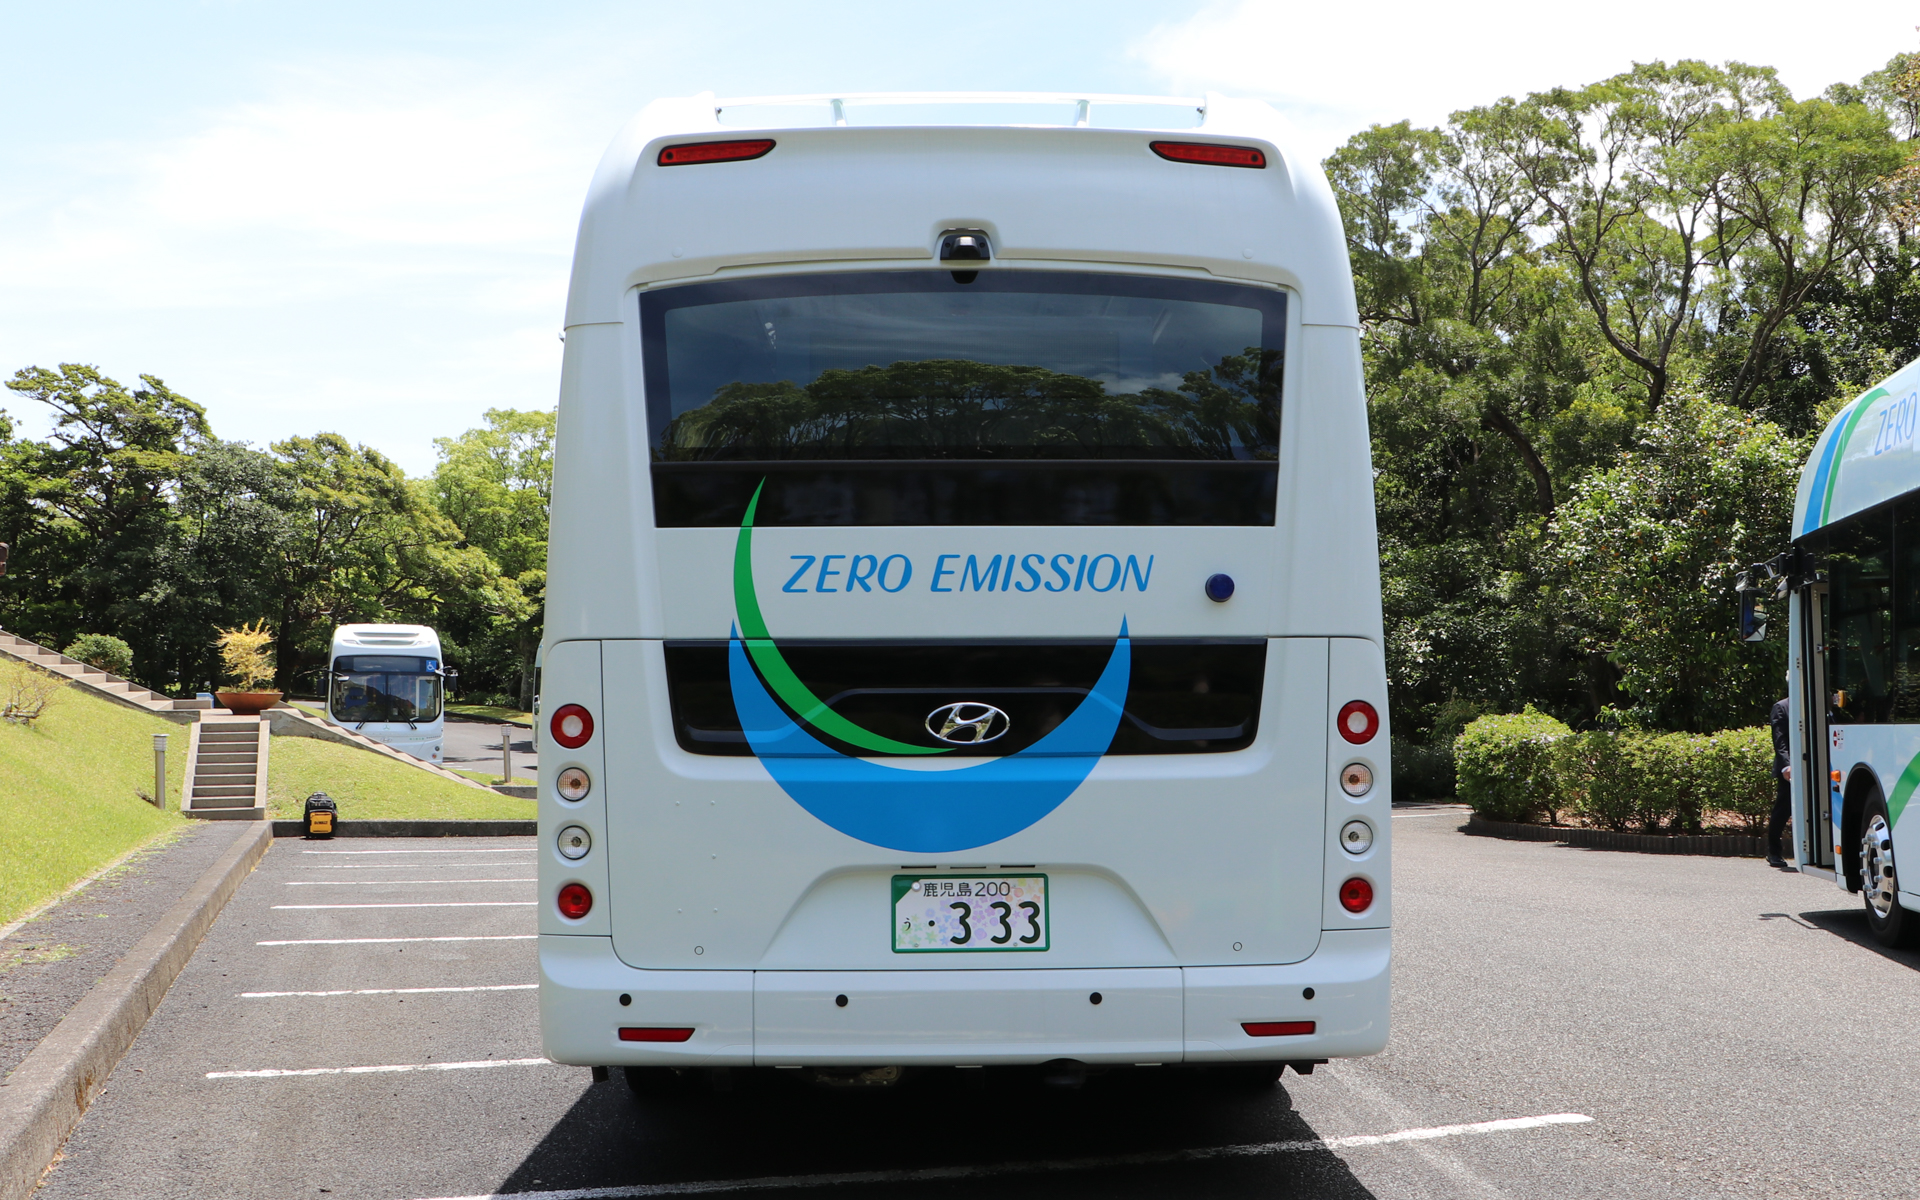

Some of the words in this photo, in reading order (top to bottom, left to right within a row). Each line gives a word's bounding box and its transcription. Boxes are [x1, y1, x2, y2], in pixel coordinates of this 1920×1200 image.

[1875, 391, 1917, 456] ZERO
[782, 553, 913, 593] ZERO
[930, 553, 1154, 593] EMISSION
